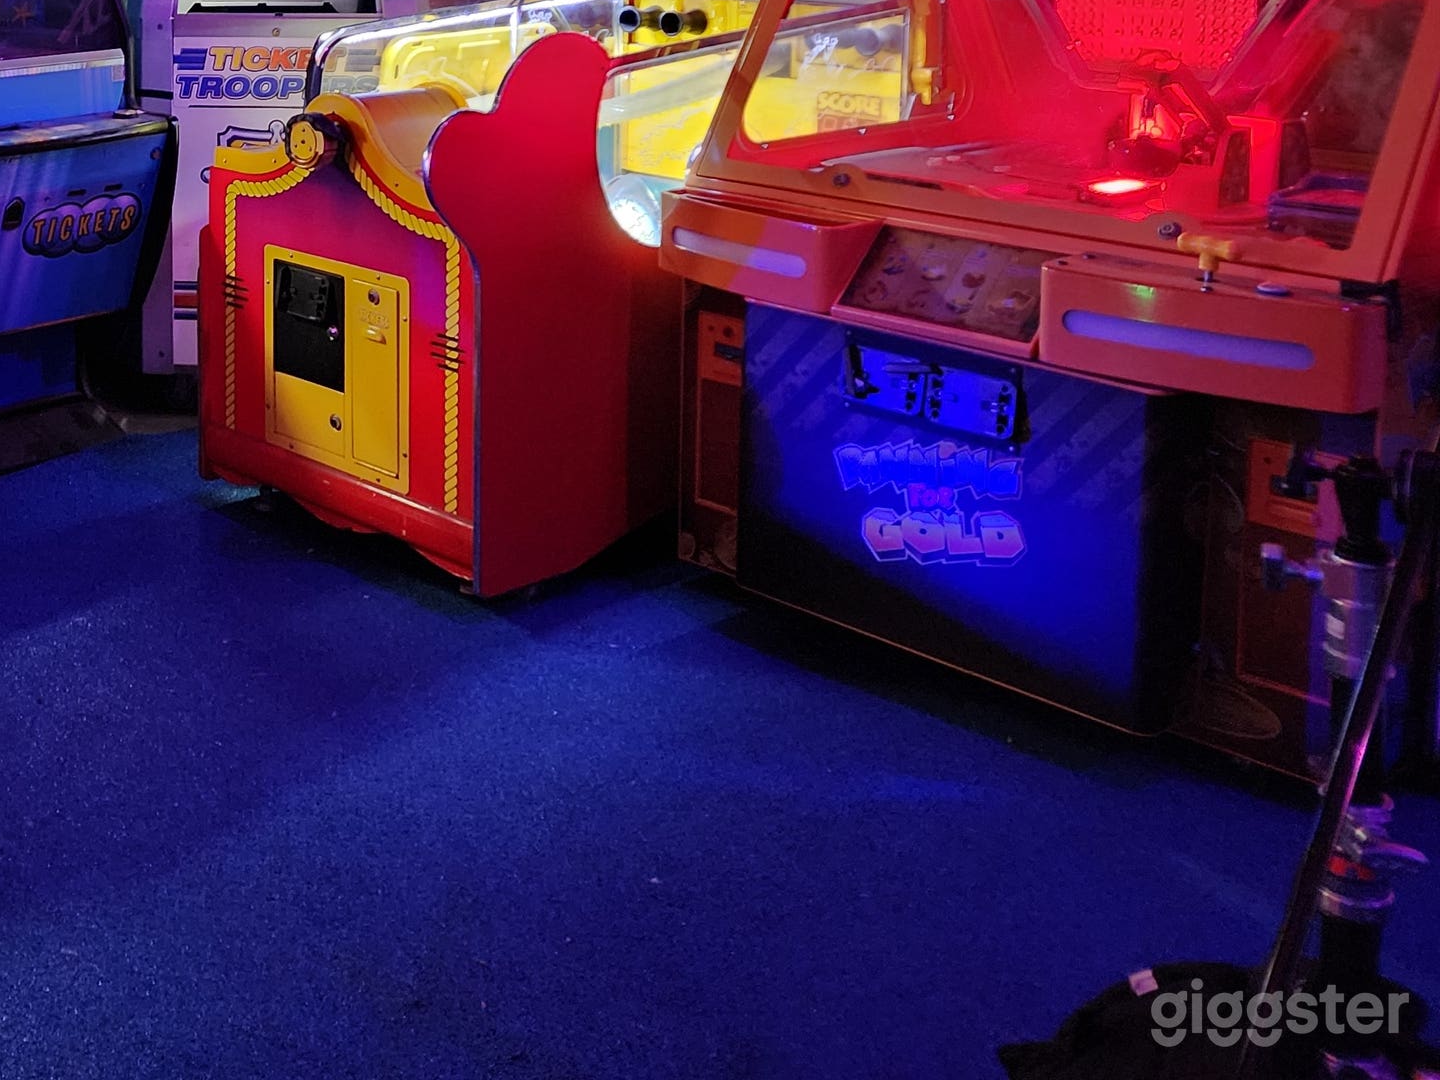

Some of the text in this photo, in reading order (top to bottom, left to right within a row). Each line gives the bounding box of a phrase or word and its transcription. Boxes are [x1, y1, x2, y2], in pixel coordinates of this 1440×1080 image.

[817, 92, 882, 117] SCORE
[32, 205, 138, 246] TICKETS
[834, 440, 1023, 499] PANNING
[909, 482, 955, 508] FOR
[863, 508, 1027, 566] GOLD
